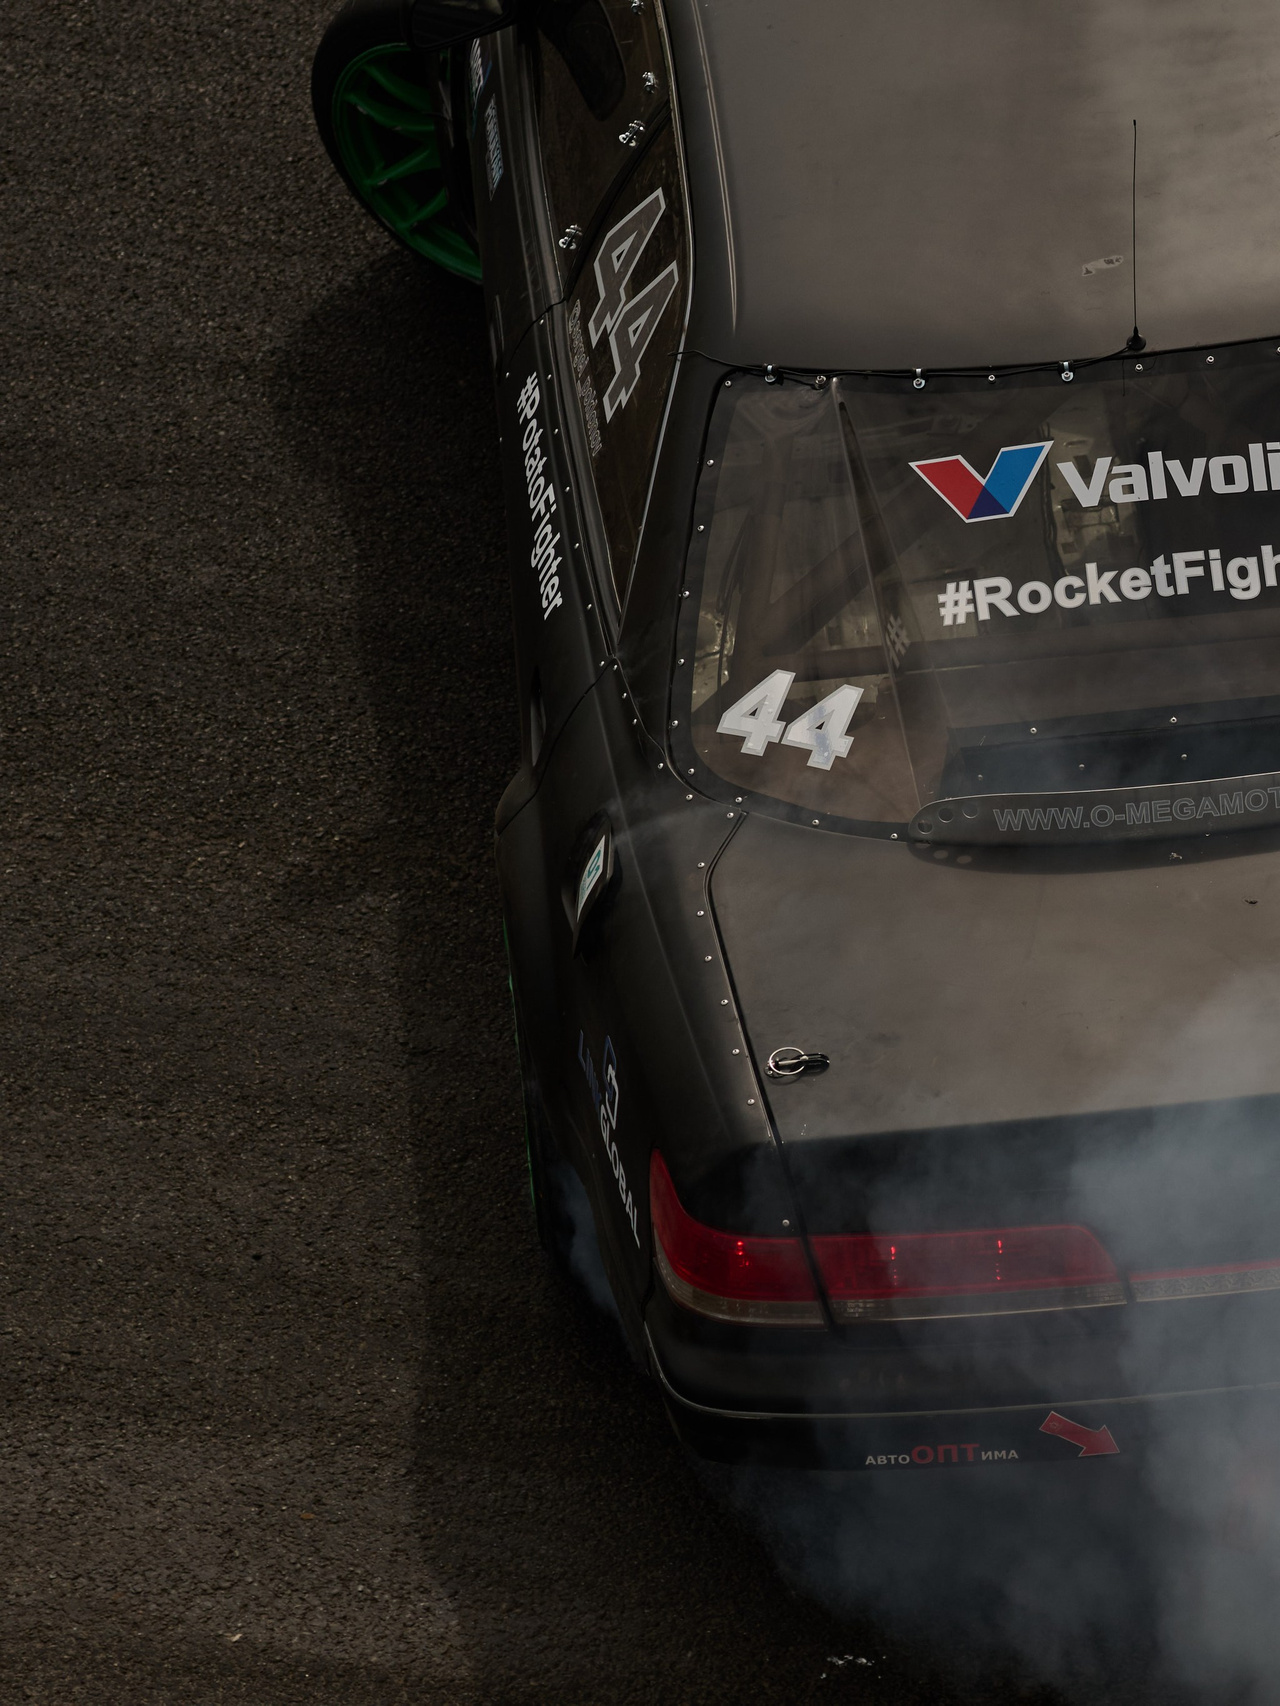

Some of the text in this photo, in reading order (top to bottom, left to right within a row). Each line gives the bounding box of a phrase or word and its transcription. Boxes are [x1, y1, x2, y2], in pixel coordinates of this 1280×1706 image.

[588, 187, 679, 424] 44
[516, 371, 563, 620] #PotatoFighter
[716, 668, 864, 771] 44
[601, 1104, 640, 1249] GLOBAL
